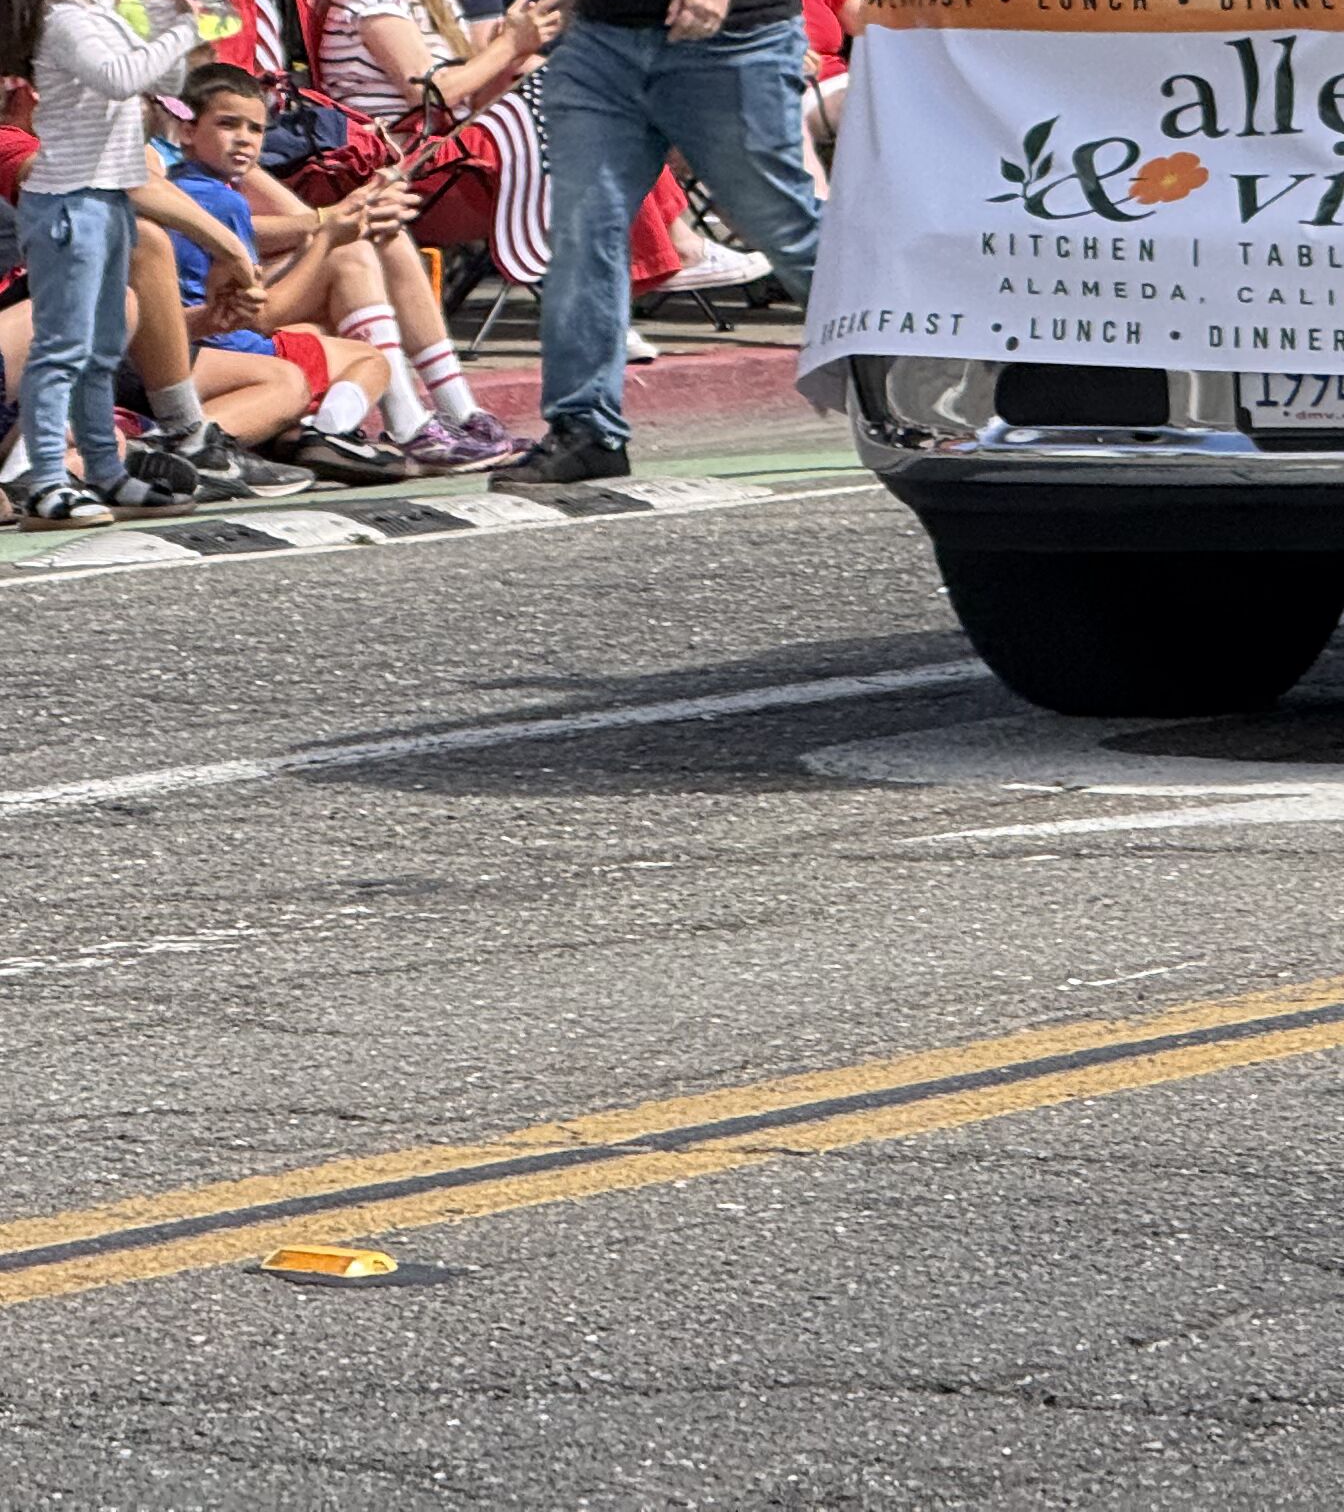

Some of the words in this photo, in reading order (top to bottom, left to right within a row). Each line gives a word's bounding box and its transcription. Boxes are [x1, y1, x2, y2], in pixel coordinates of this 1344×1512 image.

[1023, 136, 1159, 224] &
[981, 231, 1156, 263] KITCHEN
[1028, 316, 1145, 345] LUNCH
